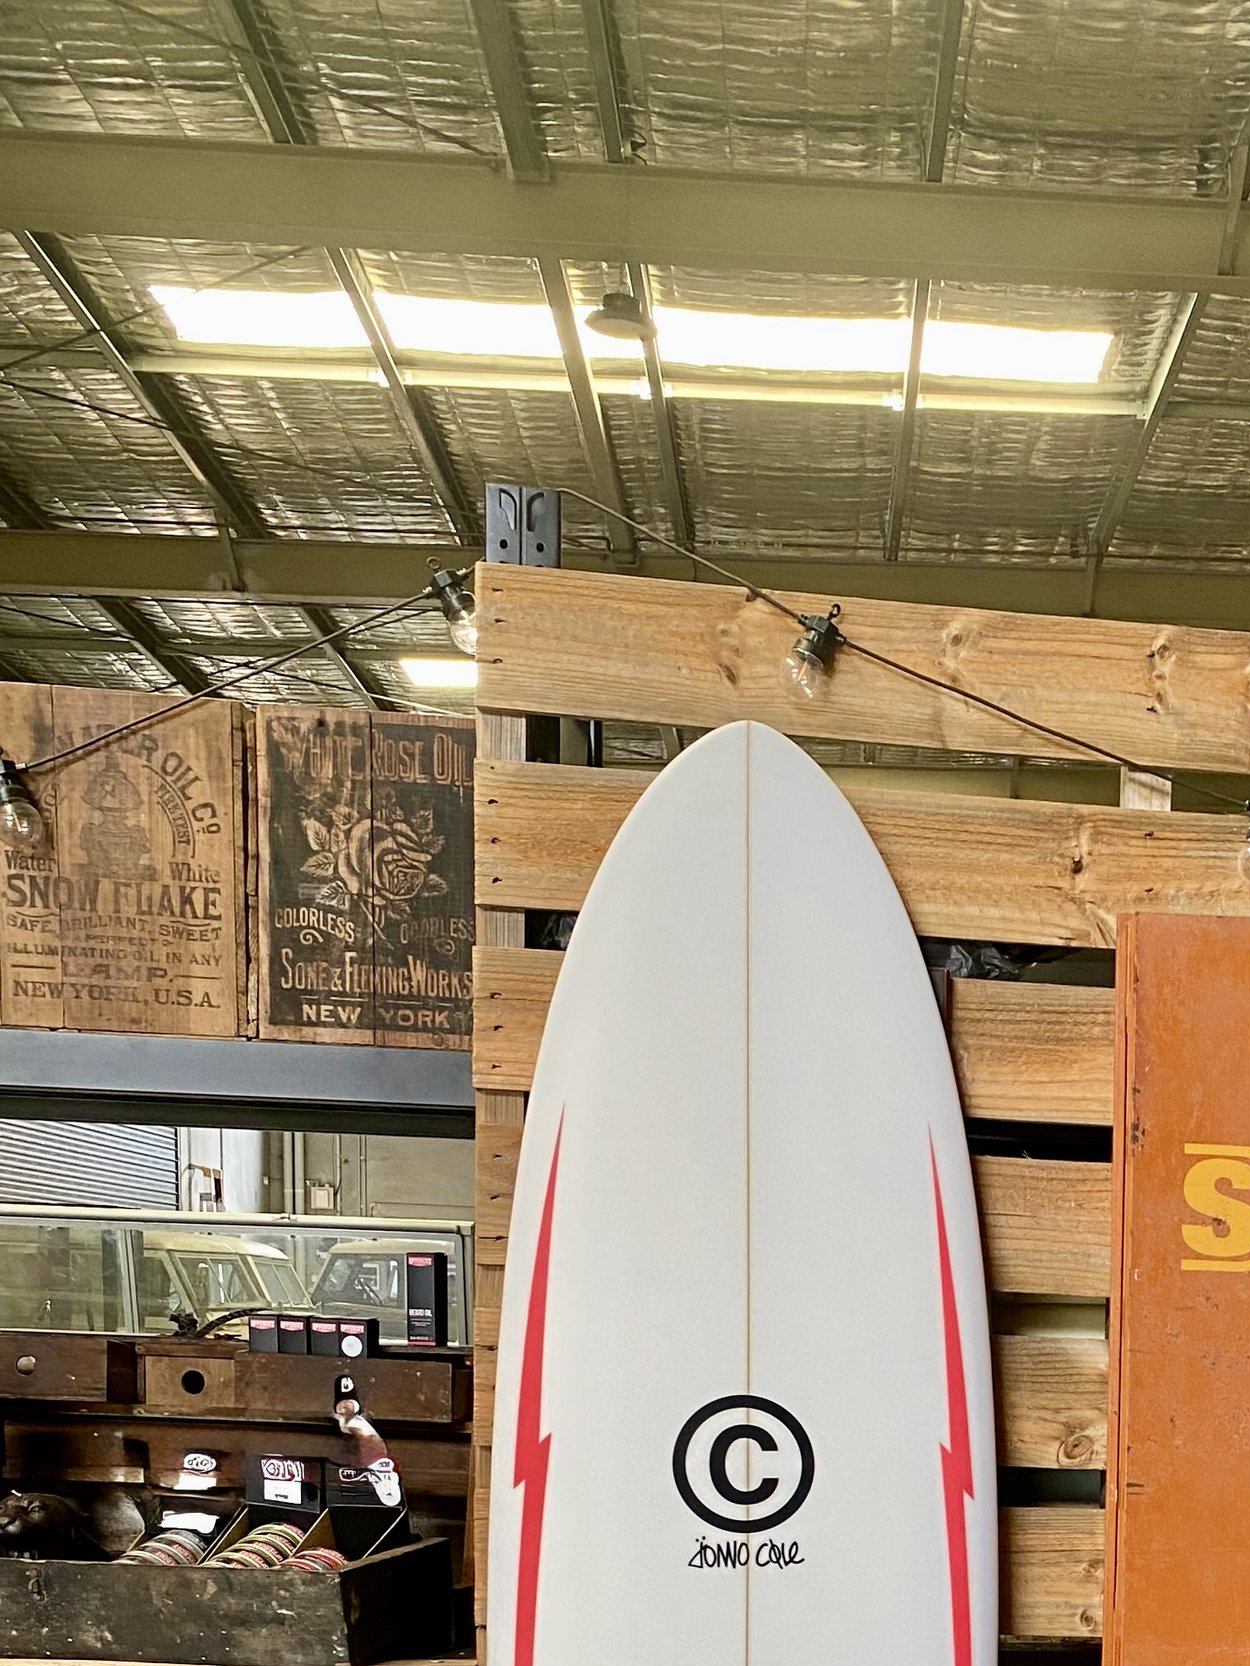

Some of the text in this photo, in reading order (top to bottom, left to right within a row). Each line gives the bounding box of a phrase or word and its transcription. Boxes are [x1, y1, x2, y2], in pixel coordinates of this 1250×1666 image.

[370, 727, 429, 785] ROSE
[433, 732, 473, 786] OIL
[160, 751, 204, 801] OIL
[5, 850, 221, 885] Water White
[6, 873, 223, 922] SNOW FLAKE
[159, 923, 223, 943] SWEET
[274, 906, 356, 943] COLORLESS
[165, 950, 183, 965] IN
[189, 953, 223, 967] ANY
[12, 979, 63, 999] NEW
[302, 1003, 451, 1030] NEW YORK
